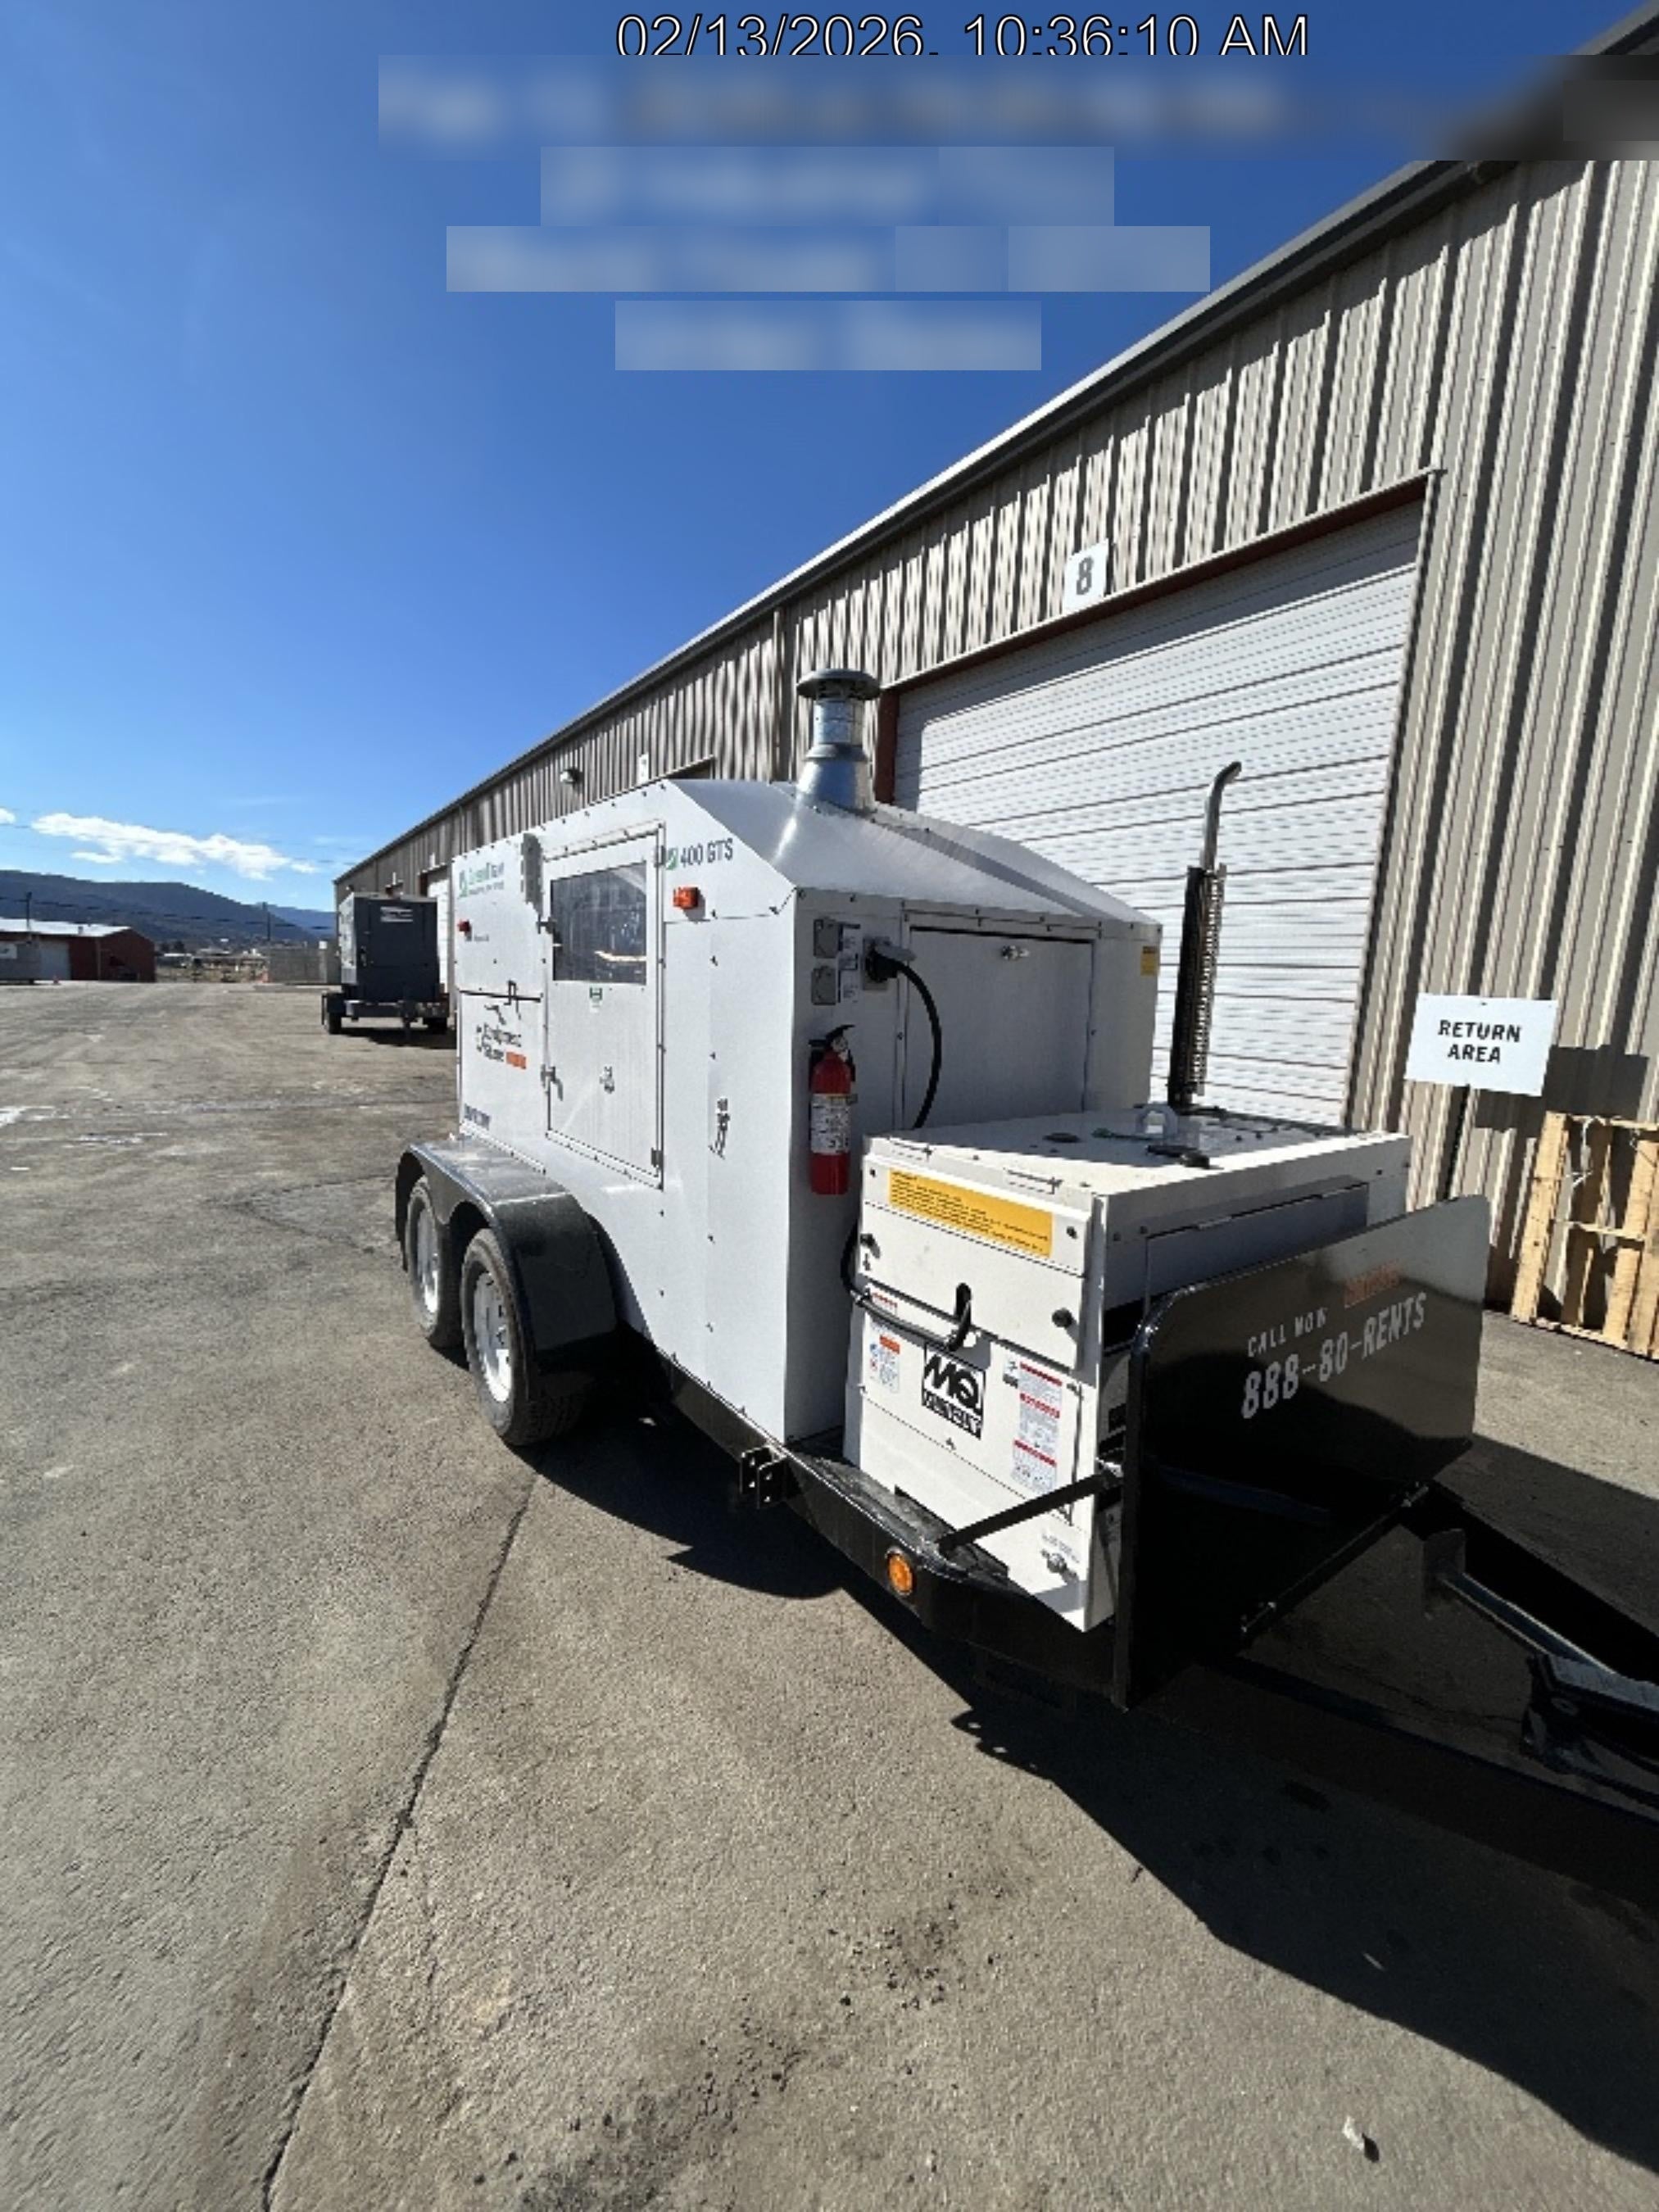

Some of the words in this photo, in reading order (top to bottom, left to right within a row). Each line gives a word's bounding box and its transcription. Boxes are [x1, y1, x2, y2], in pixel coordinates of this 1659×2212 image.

[1076, 556, 1095, 596] 8
[680, 842, 704, 868] 400
[707, 837, 733, 863] GTS
[1438, 1019, 1522, 1043] RETURN
[1448, 1044, 1501, 1064] AREA
[1241, 1291, 1426, 1419] 888-80-RENTS
[1248, 1324, 1286, 1357] CALL
